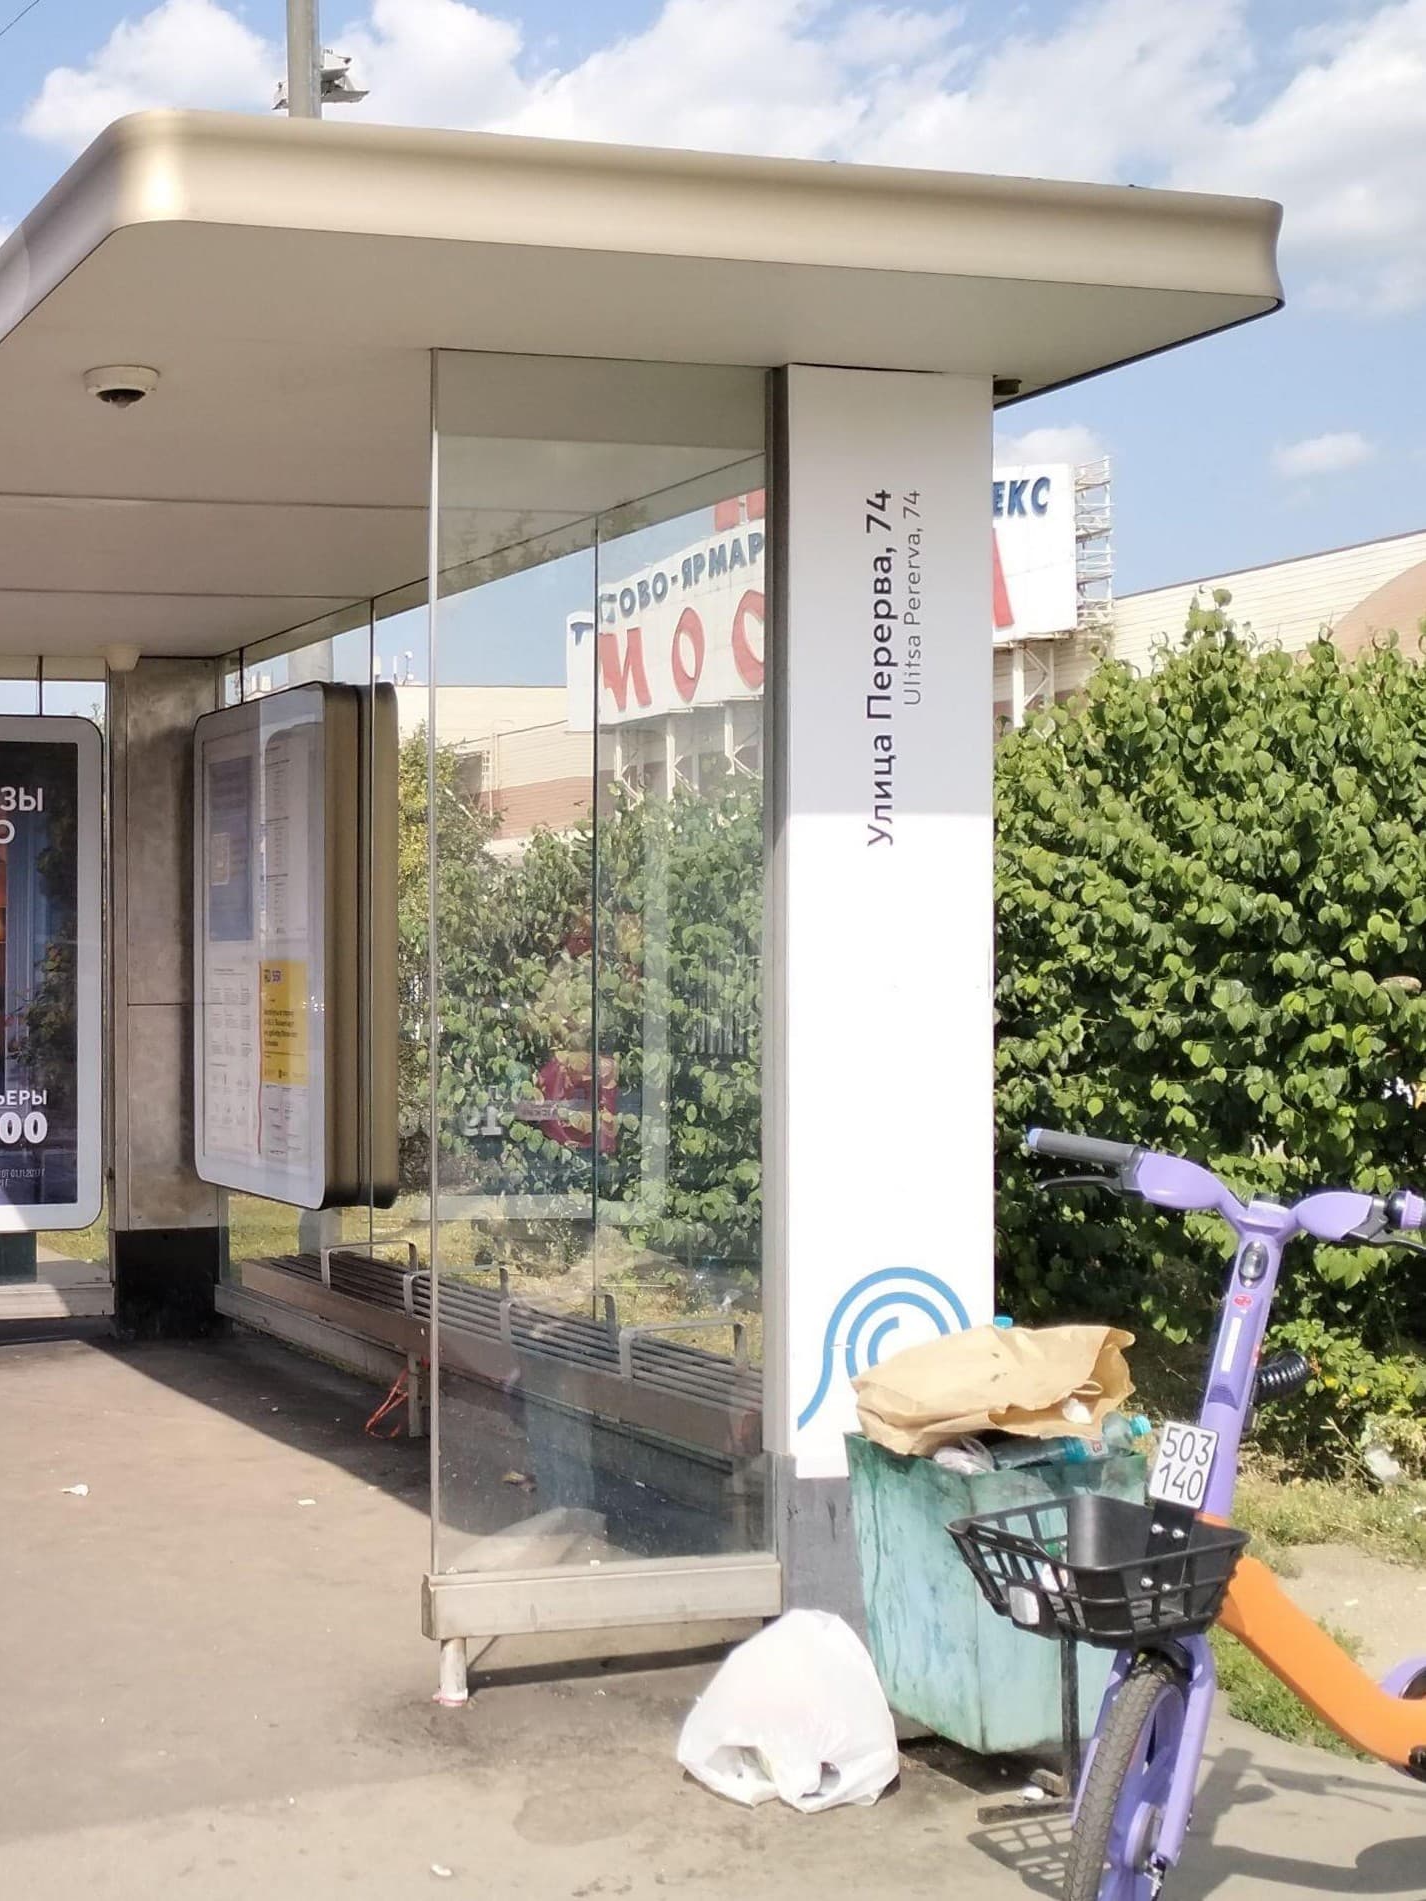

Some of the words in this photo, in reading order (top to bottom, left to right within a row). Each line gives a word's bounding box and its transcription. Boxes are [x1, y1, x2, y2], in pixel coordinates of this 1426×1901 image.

[866, 489, 892, 533] 74
[903, 490, 921, 519] 74
[903, 527, 924, 626] Pererva,
[867, 547, 898, 720] Перерва,
[903, 637, 921, 705] Ulitsa
[867, 734, 896, 847] Улица
[1162, 1427, 1215, 1466] 503
[1158, 1465, 1205, 1500] 140
